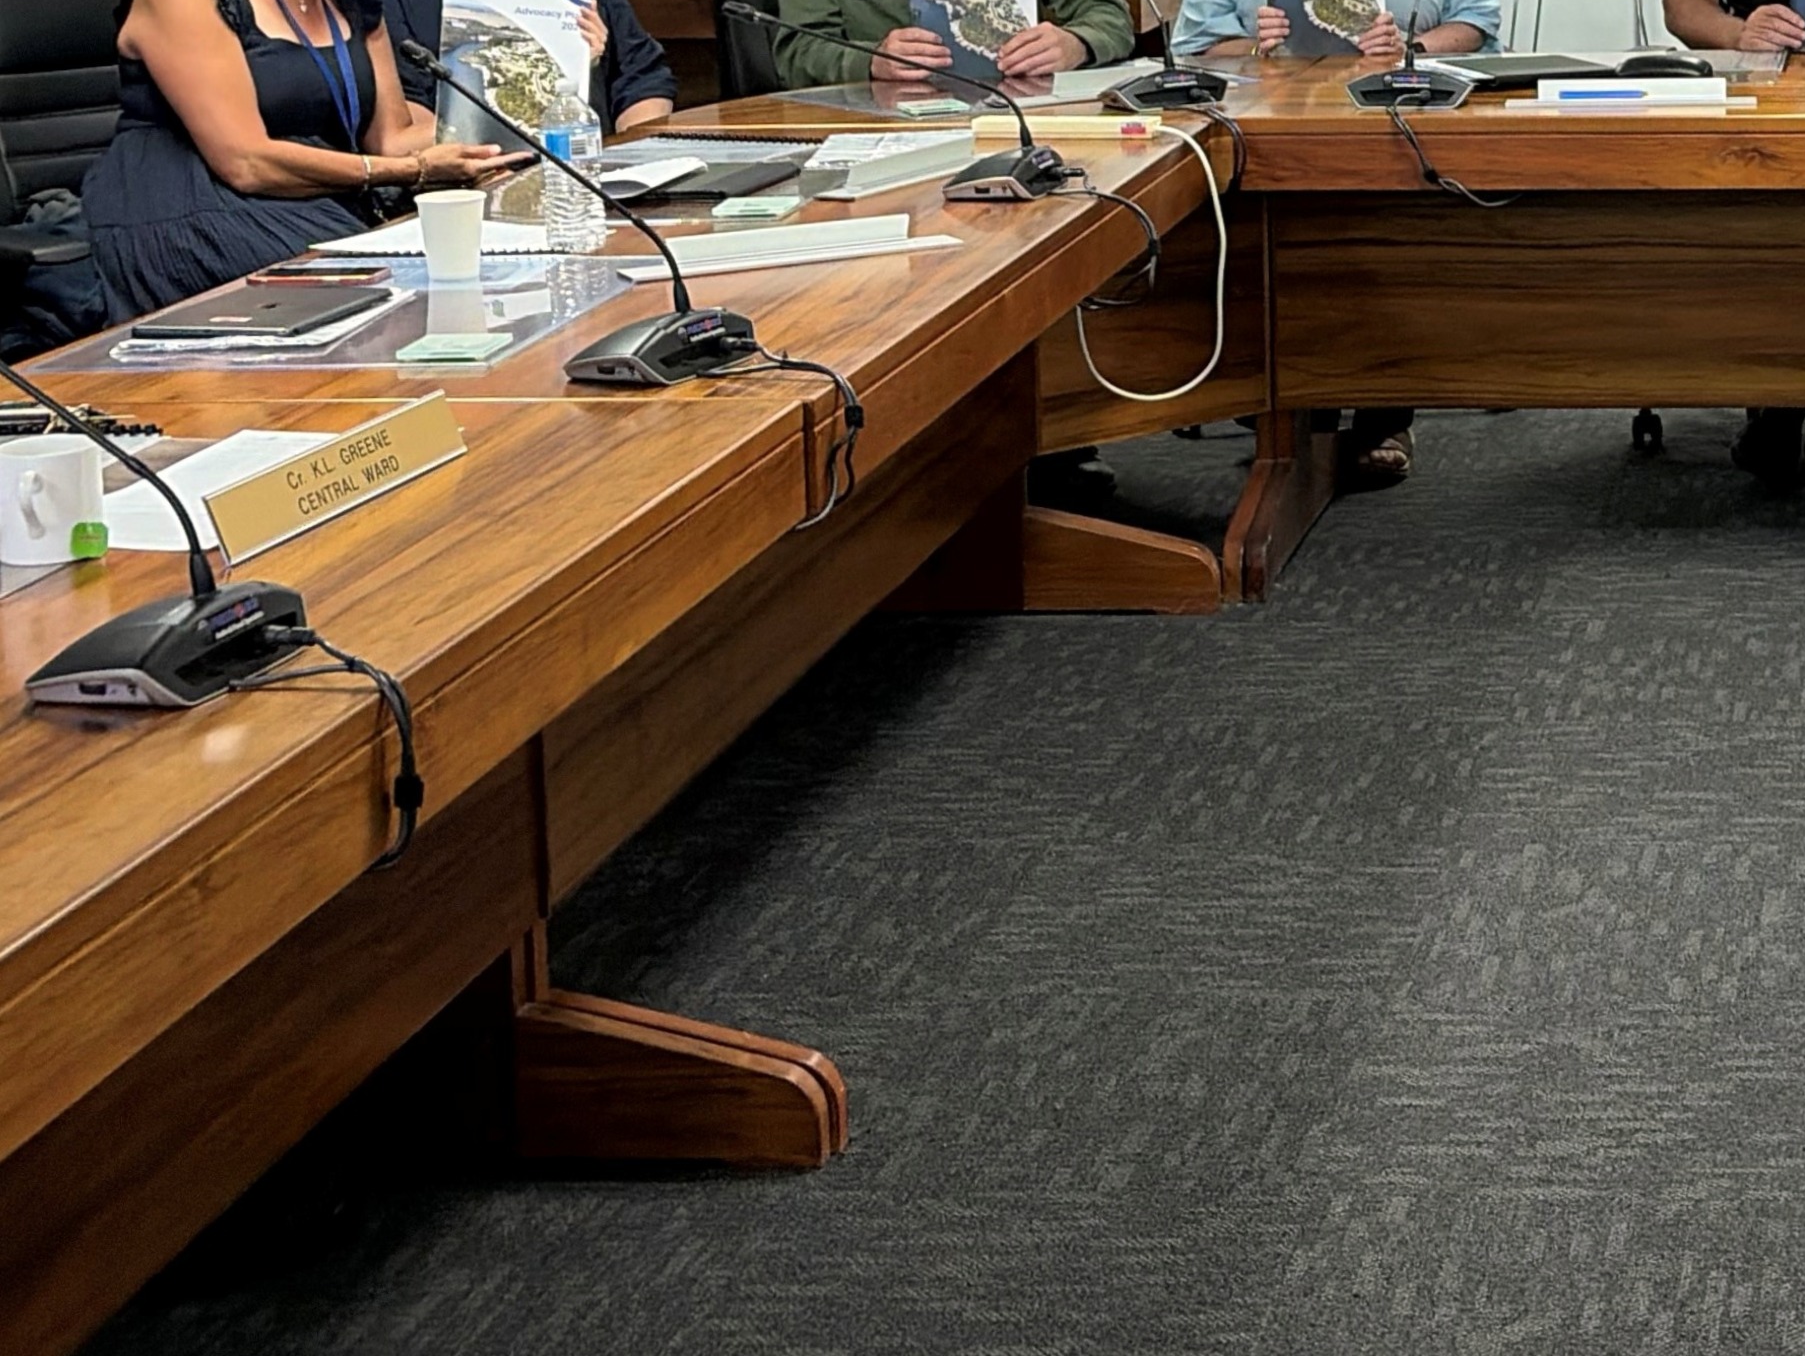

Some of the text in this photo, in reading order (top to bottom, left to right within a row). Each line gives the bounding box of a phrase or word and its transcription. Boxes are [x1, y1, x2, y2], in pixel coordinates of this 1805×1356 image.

[514, 6, 561, 20] Advocacy
[286, 471, 307, 490] Cr.
[339, 428, 393, 466] GREENE
[297, 455, 400, 515] CENTRAL WARD
